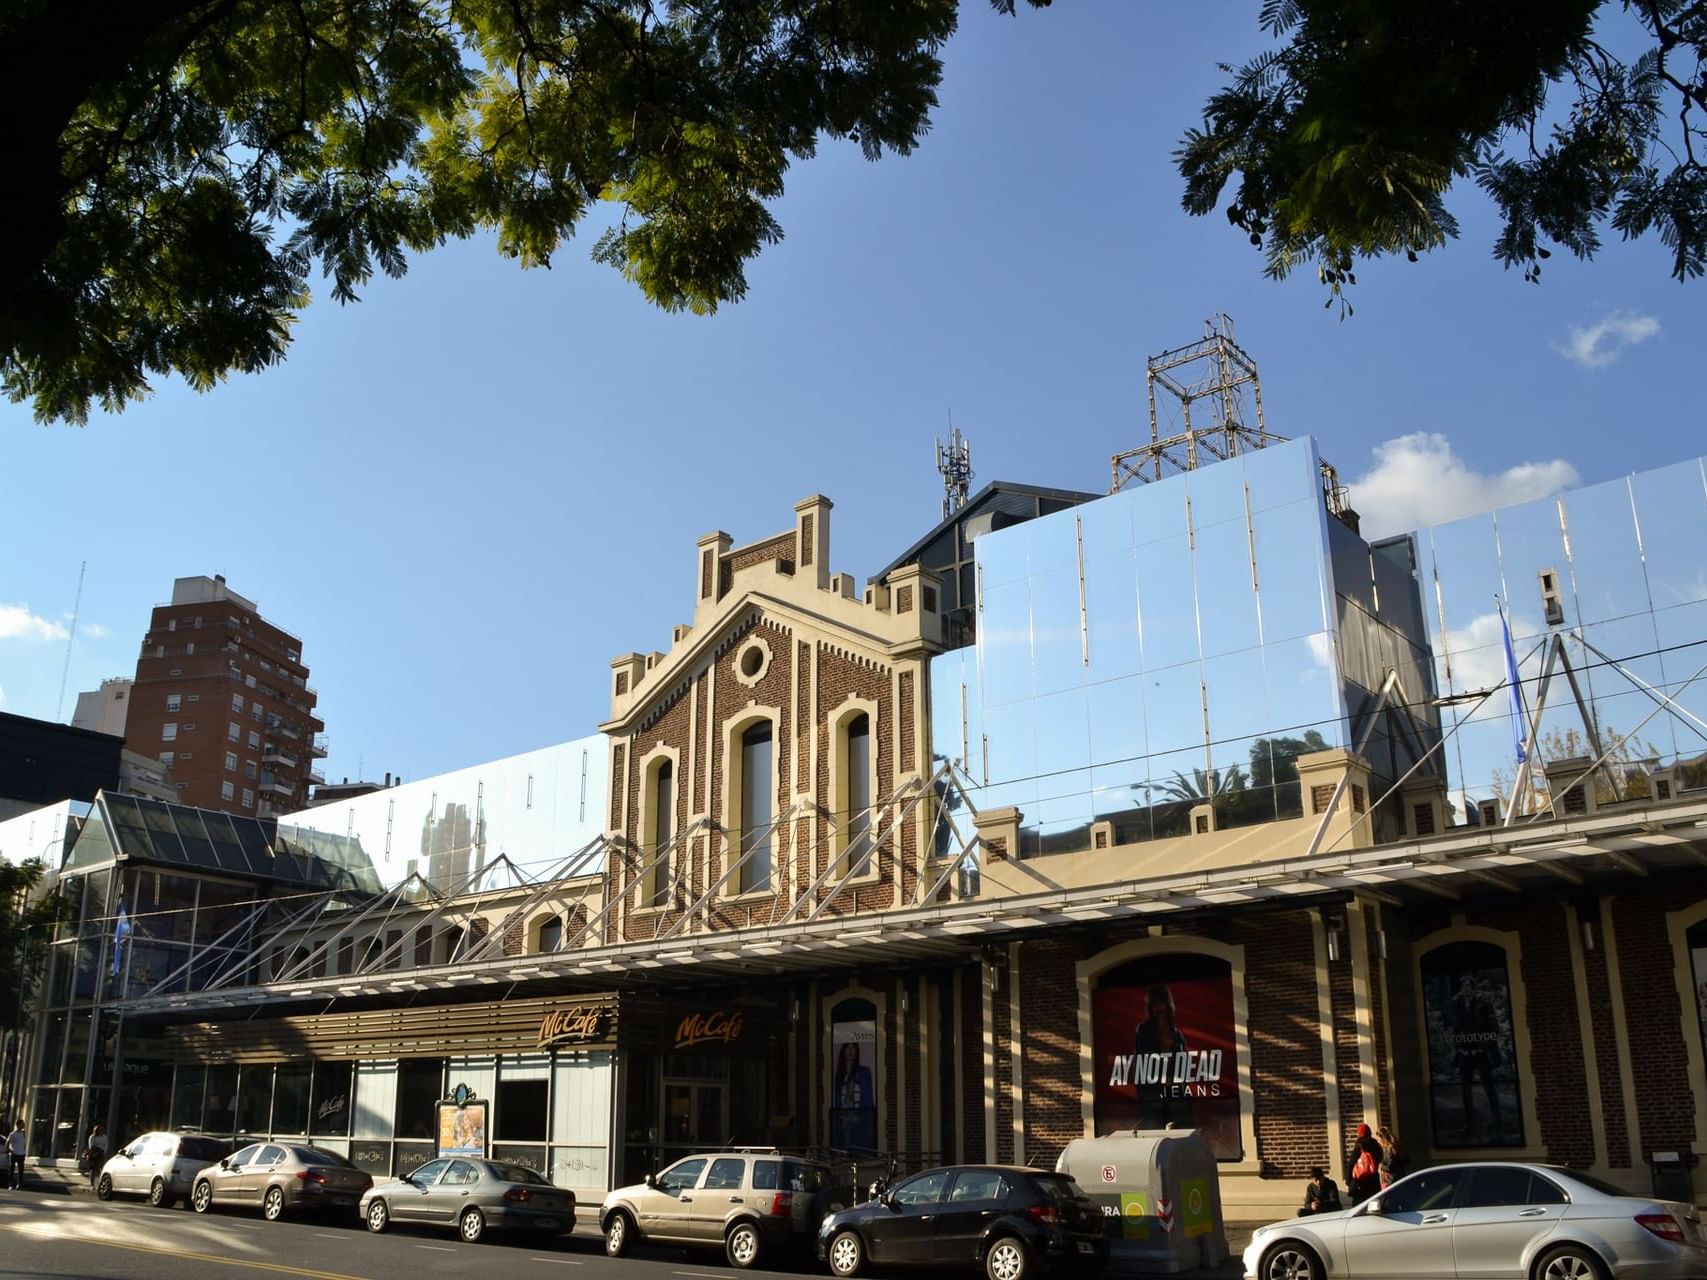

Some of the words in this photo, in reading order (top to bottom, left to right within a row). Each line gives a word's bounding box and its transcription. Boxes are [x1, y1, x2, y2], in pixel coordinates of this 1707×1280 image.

[537, 1006, 599, 1047] McCafé
[674, 1011, 743, 1048] McCafé
[1109, 1055, 1134, 1086] AY
[1134, 1053, 1172, 1085] NOT
[1173, 1049, 1222, 1083] DEAD
[1160, 1083, 1220, 1099] JEANS
